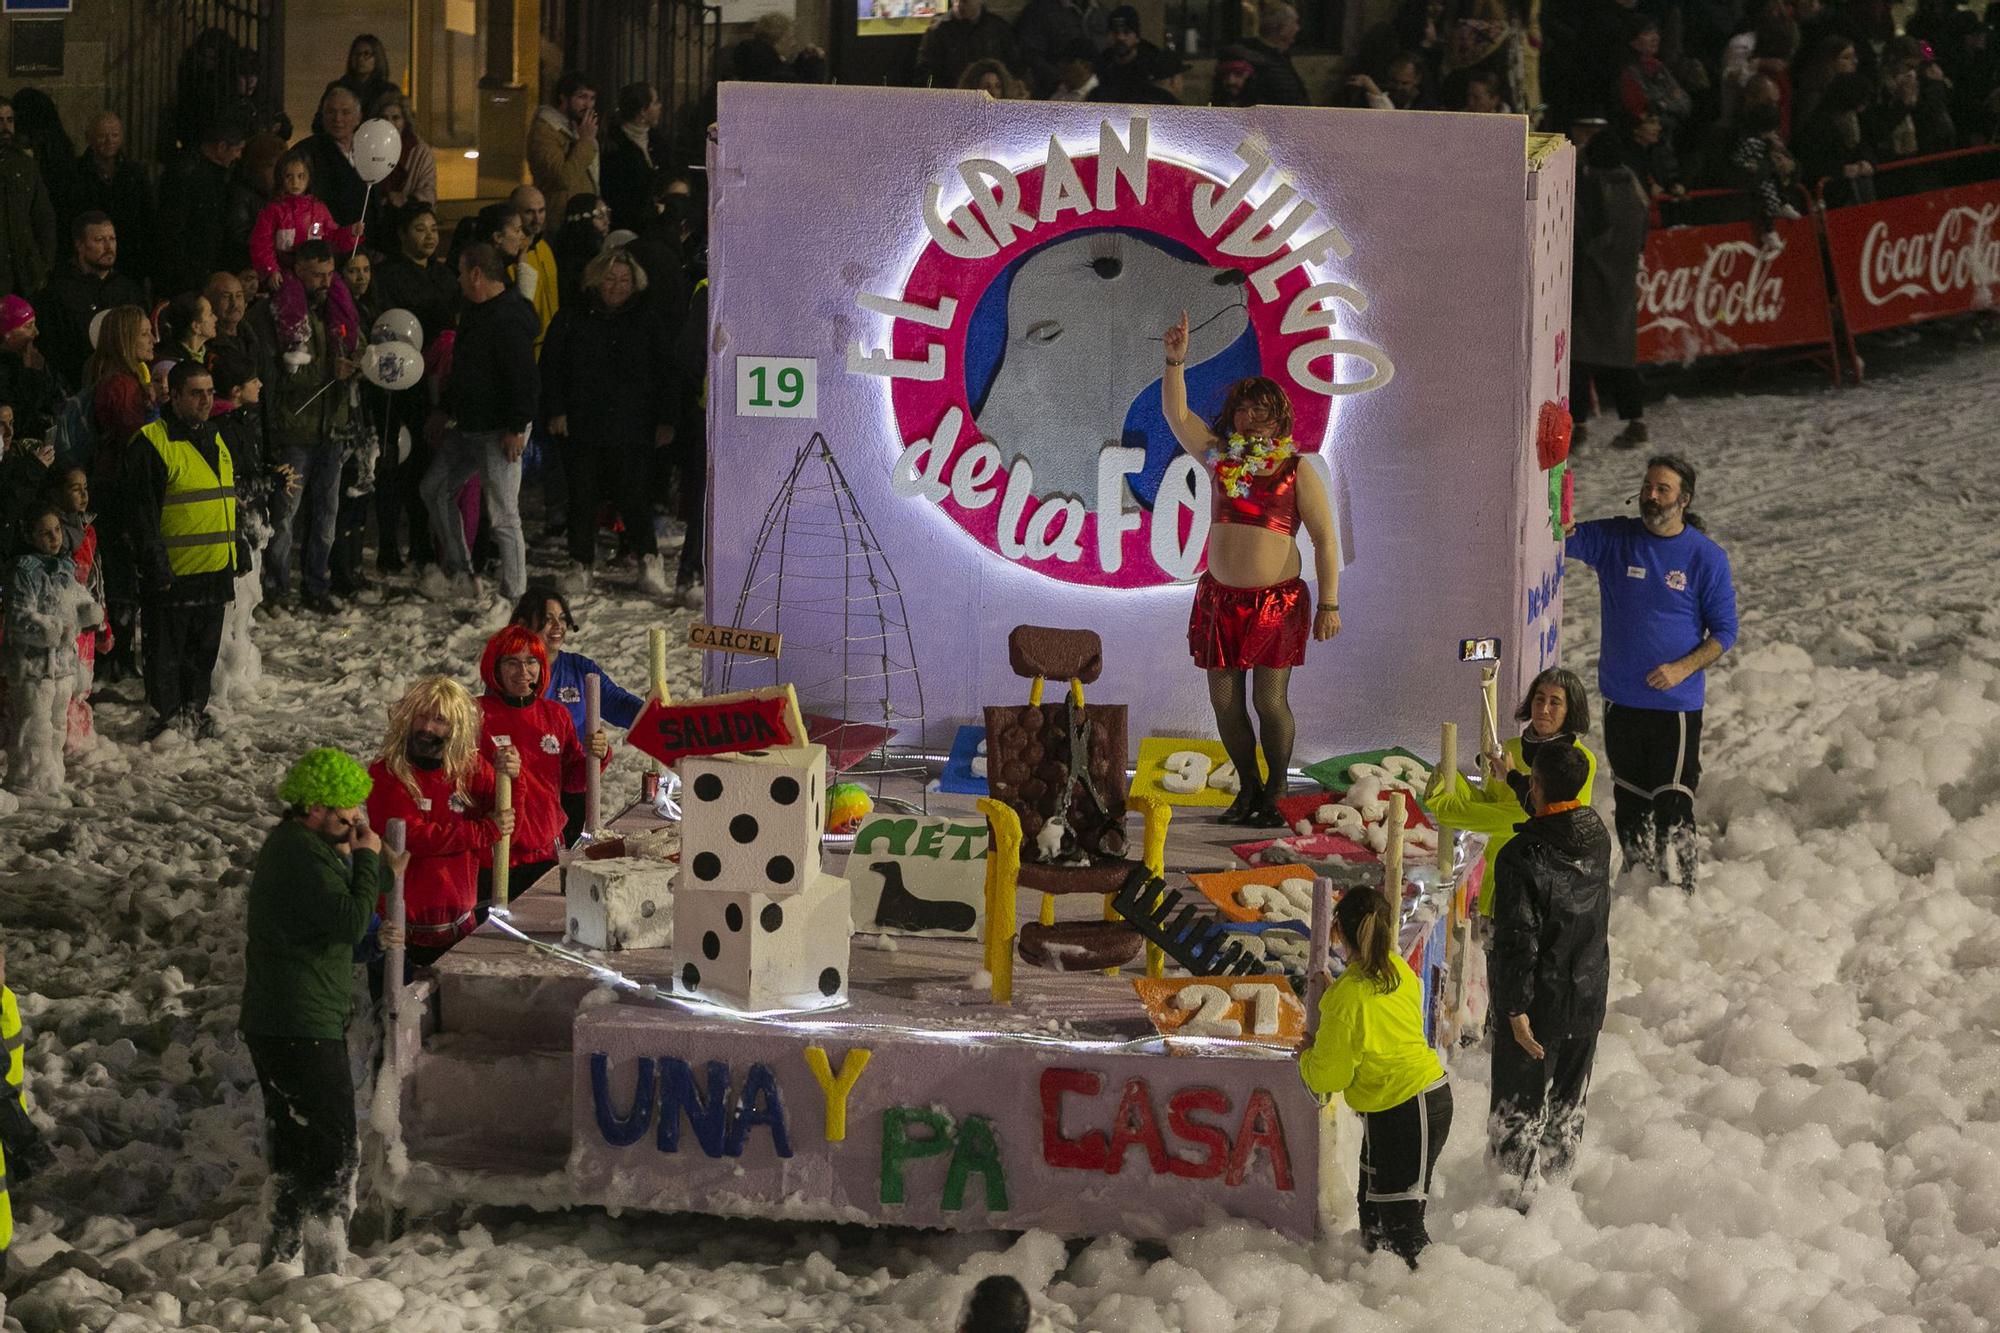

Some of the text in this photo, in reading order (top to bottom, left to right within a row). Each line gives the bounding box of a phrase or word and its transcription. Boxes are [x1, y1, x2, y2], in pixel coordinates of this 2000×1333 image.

[846, 293, 958, 381] EL
[922, 116, 1150, 259] GRAN
[1192, 140, 1395, 396] JUEGO
[1635, 240, 1787, 334] oca-Cola
[747, 366, 805, 408] 19
[892, 406, 1003, 508] de
[996, 456, 1086, 562] la
[658, 711, 777, 750] SALIDA
[853, 818, 987, 861] MET
[1176, 983, 1280, 1037] 27
[590, 1045, 1295, 1211] UNA Y PA CASA
